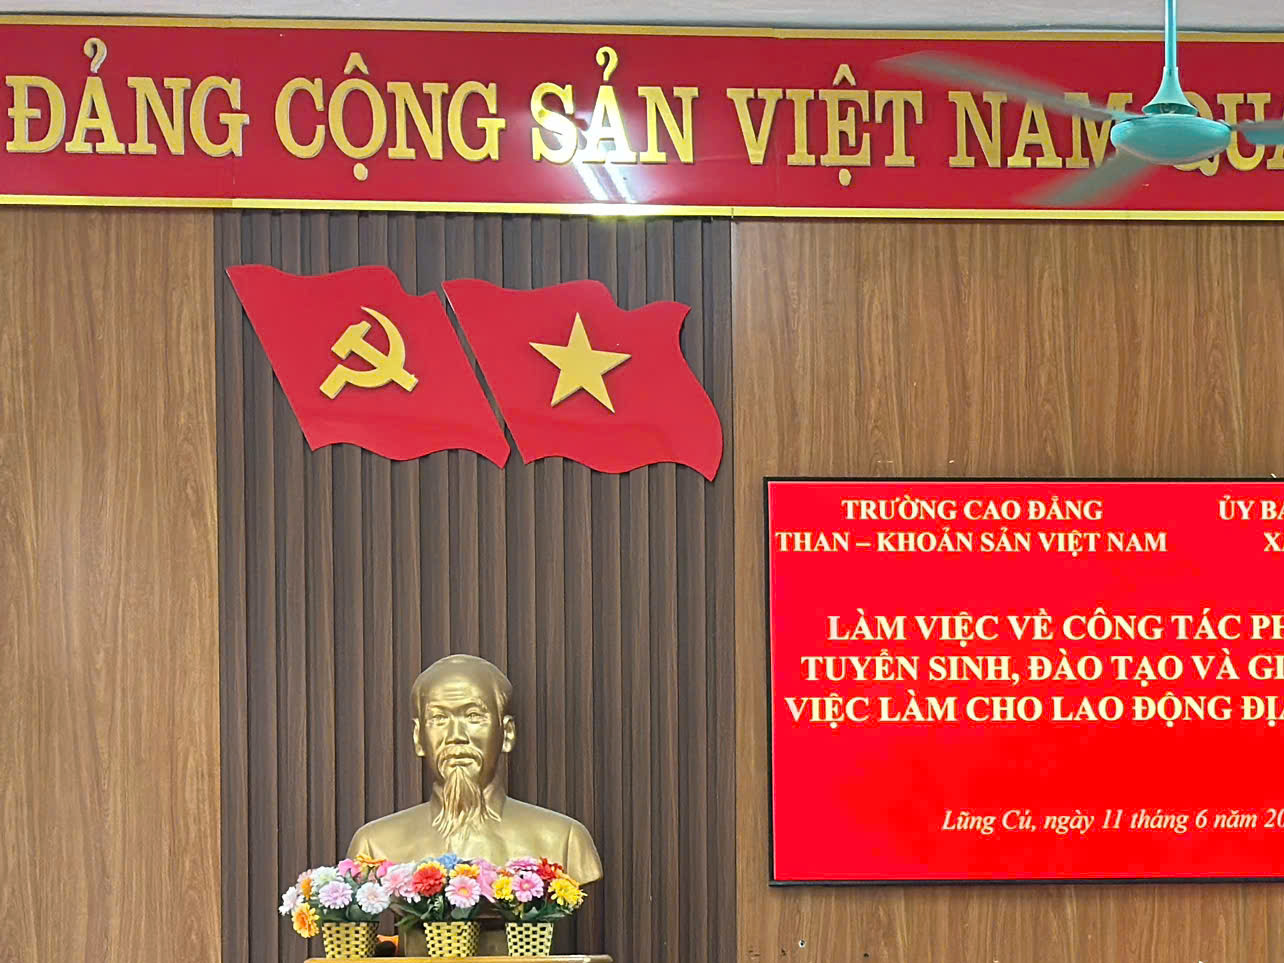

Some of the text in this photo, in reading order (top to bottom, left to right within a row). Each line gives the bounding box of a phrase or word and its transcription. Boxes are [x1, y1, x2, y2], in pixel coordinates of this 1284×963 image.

[6, 38, 250, 157] ĐẢNG
[275, 53, 506, 181] CỘNG
[530, 46, 698, 164] SẢN
[727, 64, 922, 187] VIỆT
[949, 91, 1133, 169] NAM
[841, 494, 958, 521] TRƯỜNG
[963, 499, 1021, 521] CAO
[1218, 494, 1255, 521] ỦY
[775, 531, 850, 553] THAN
[876, 526, 973, 553] KHOẢN
[980, 526, 1031, 553] SẢN
[1037, 529, 1101, 558] VIỆT
[1107, 531, 1167, 553] NAM
[827, 607, 907, 641] LÀM
[914, 611, 999, 648] VIỆC
[1006, 607, 1054, 641] VỀ
[1058, 607, 1164, 641] CÔNG
[1170, 607, 1241, 641] TÁC
[928, 655, 1020, 686] SINH,
[1027, 647, 1103, 681] ĐÀO
[1110, 655, 1184, 688] TẠO
[1191, 647, 1241, 681] VÀ
[783, 692, 870, 729] VIỆC
[878, 689, 958, 722] LÀM
[965, 695, 1043, 722] CHO
[1051, 695, 1125, 721] LAO
[1131, 691, 1233, 728] ĐỘNG
[941, 809, 997, 835] Lũng
[1001, 809, 1037, 833] Cú,
[1043, 808, 1095, 835] ngày
[1102, 809, 1123, 829] 11
[1130, 808, 1190, 834] tháng
[1195, 809, 1209, 829] 6
[1213, 808, 1258, 829] năm
